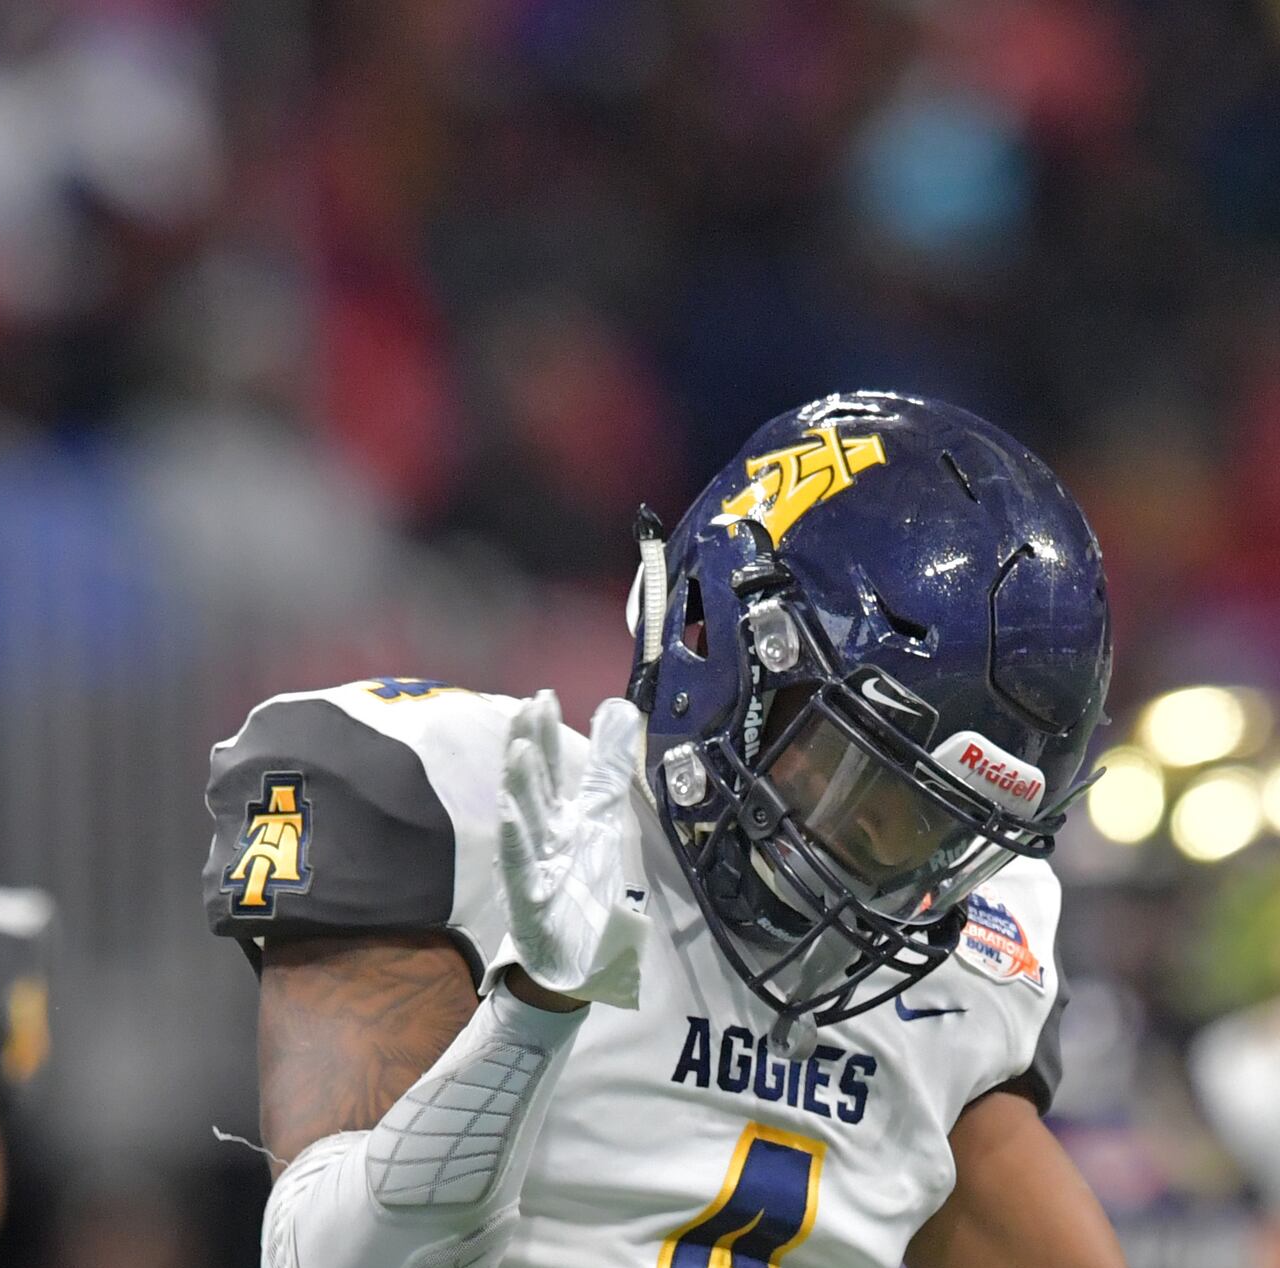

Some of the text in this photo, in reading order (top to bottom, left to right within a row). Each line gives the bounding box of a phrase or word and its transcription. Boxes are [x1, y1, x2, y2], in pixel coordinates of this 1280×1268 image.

[959, 743, 1042, 802] Riddell
[965, 937, 1003, 964] BOWL
[670, 1015, 878, 1125] AGGIES
